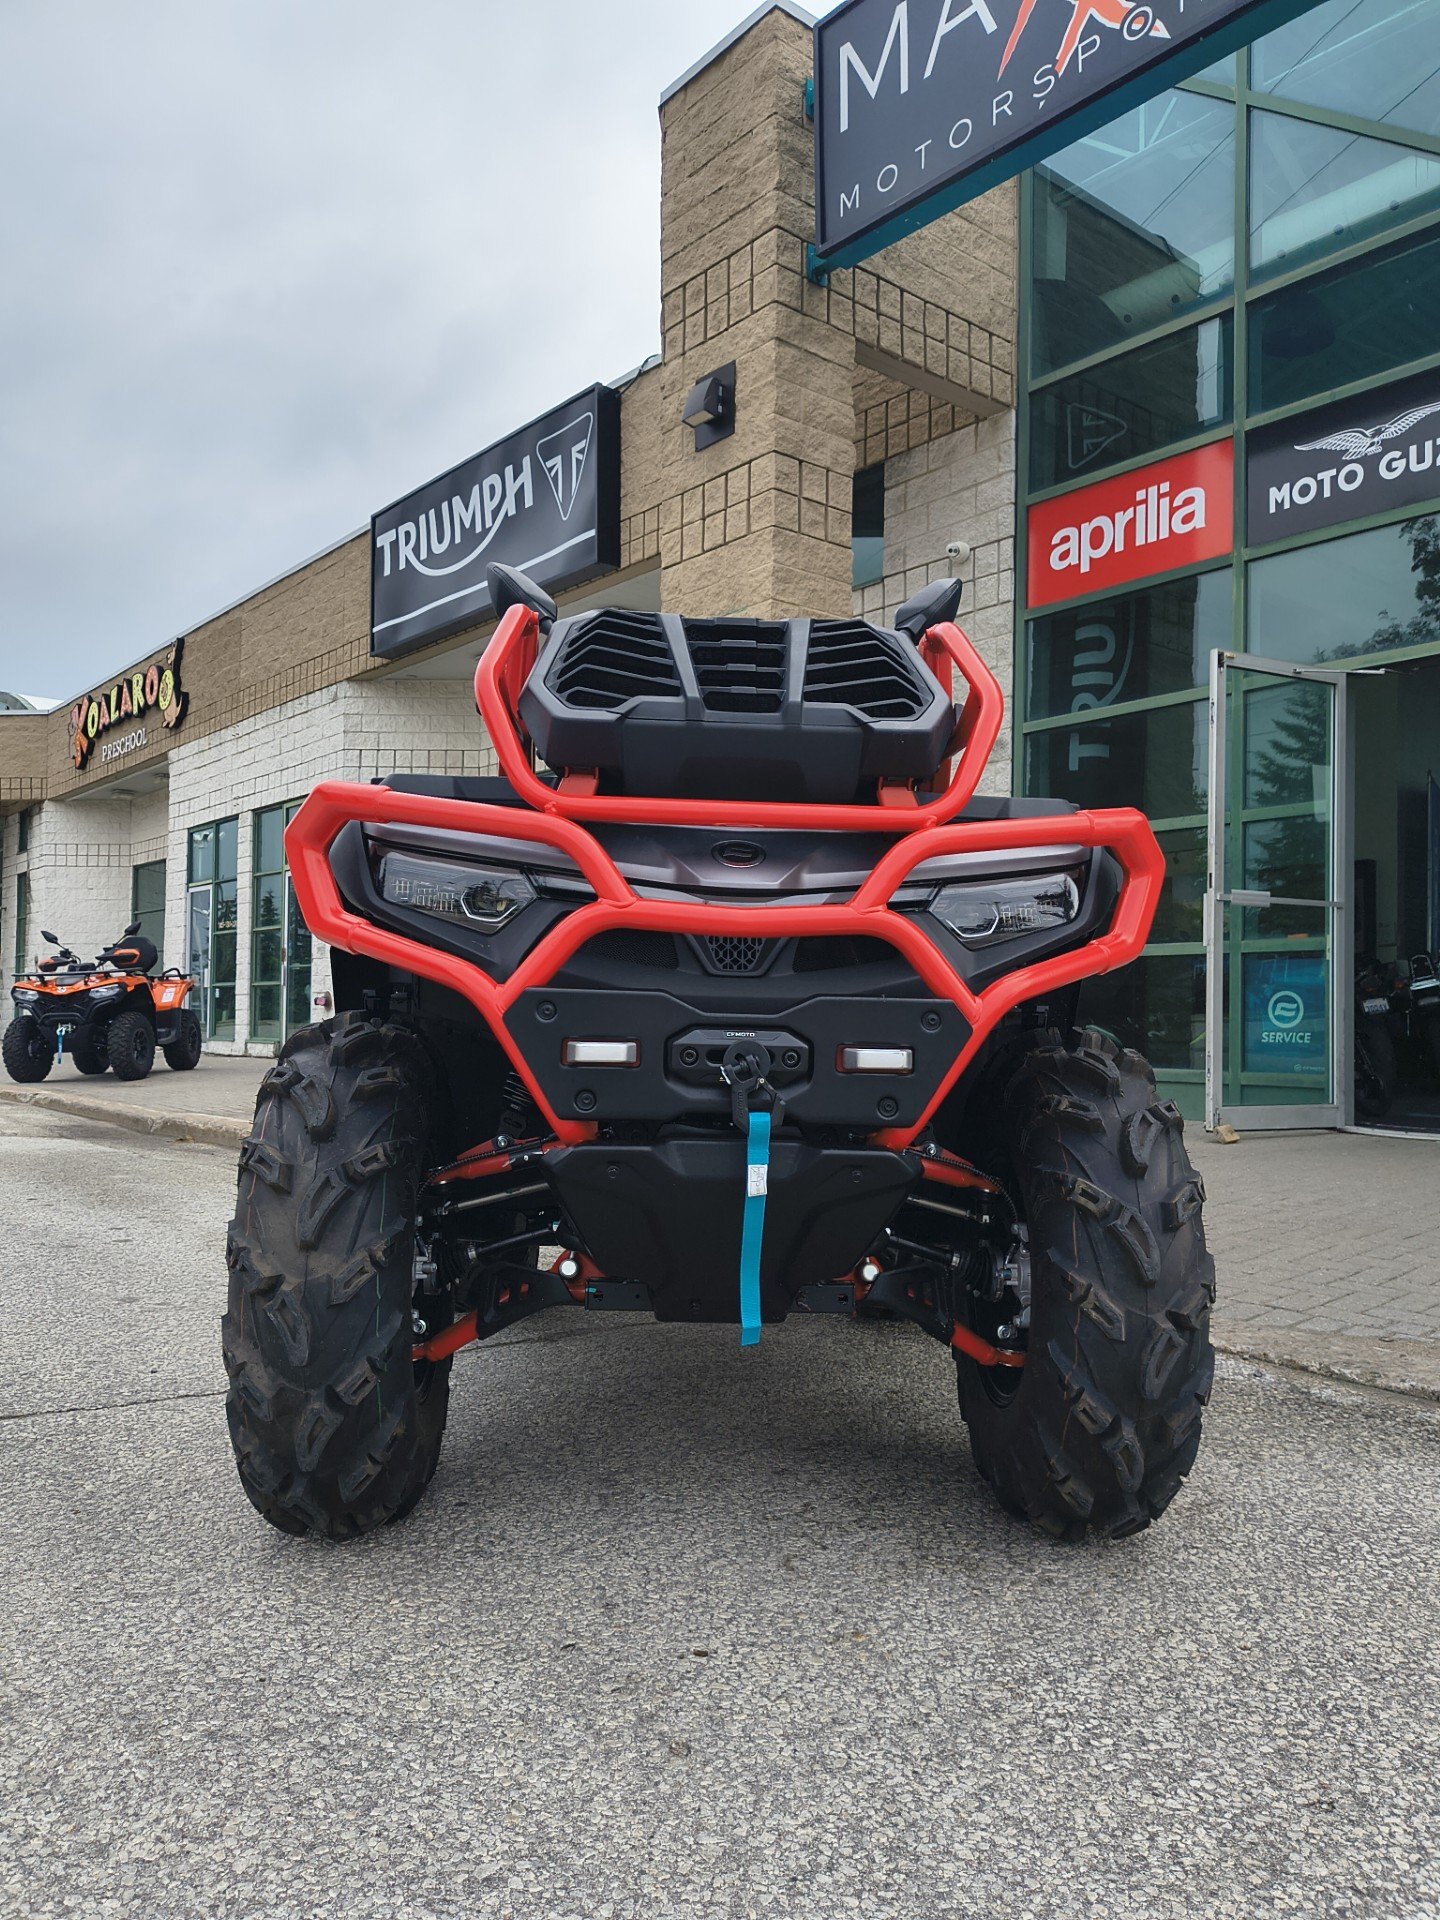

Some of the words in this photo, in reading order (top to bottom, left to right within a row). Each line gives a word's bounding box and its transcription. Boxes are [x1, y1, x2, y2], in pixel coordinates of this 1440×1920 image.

[838, 0, 1204, 218] MOTORSPO
[376, 454, 534, 577] TRIUMPH
[1048, 481, 1206, 574] aprilia
[1269, 463, 1365, 514] MOTO
[69, 664, 175, 769] KOALAROO
[102, 728, 148, 762] PRESCHOOL
[1261, 1031, 1312, 1043] SERVICE
